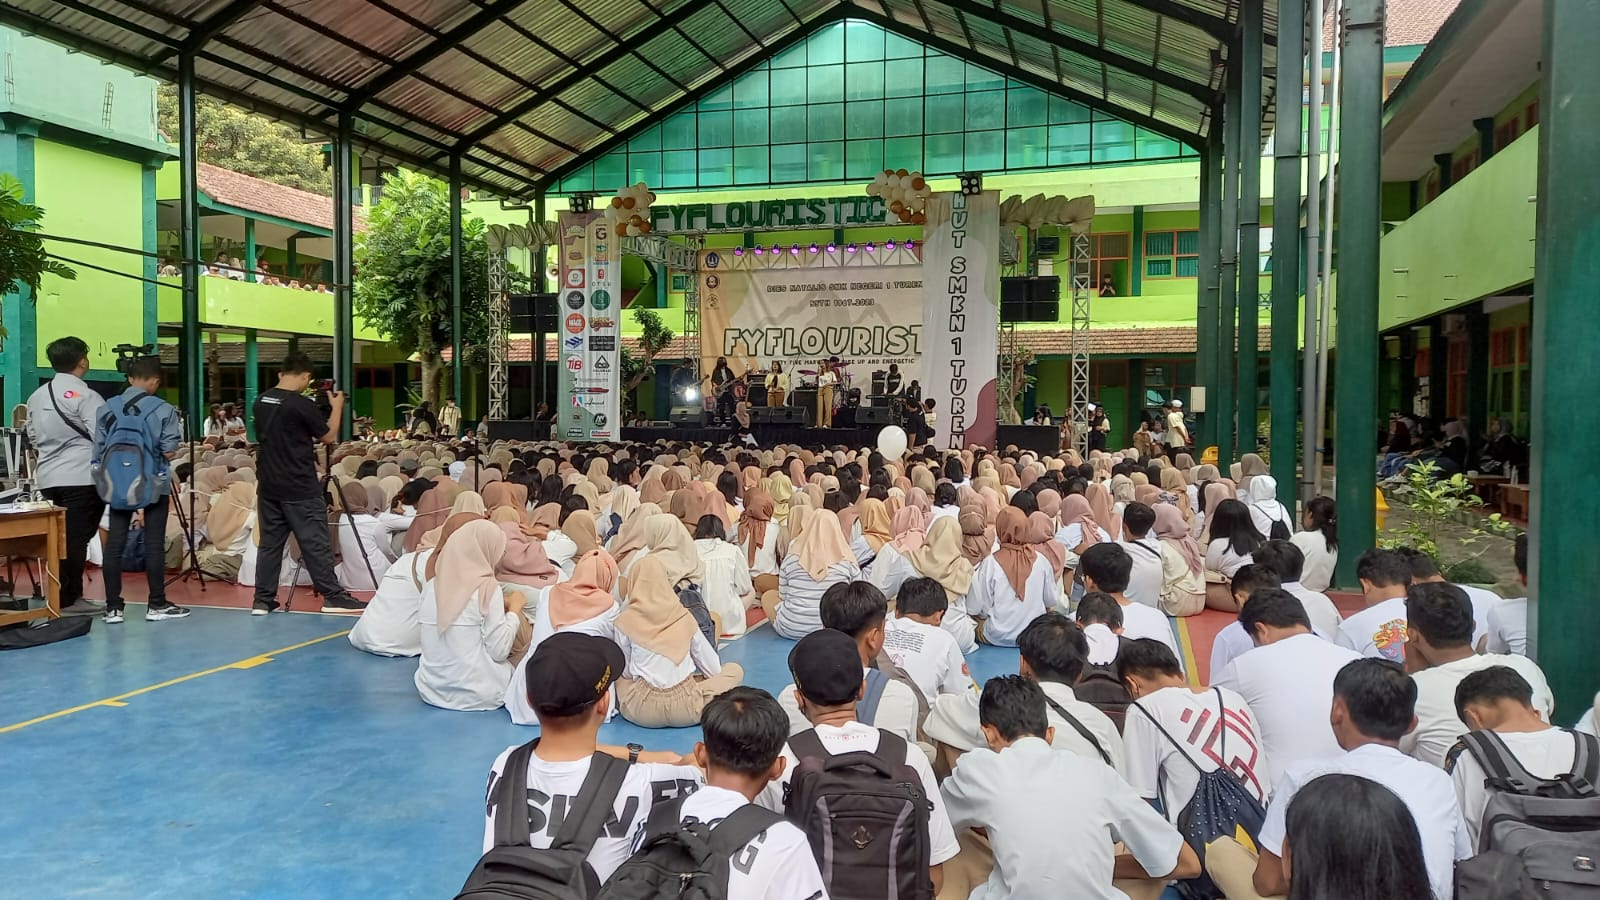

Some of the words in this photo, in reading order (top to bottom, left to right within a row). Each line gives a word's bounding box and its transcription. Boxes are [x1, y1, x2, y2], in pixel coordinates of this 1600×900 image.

[651, 195, 887, 231] FYFLOURISTIC
[951, 191, 968, 249] HUT
[789, 283, 827, 292] NATALIS
[828, 282, 848, 290] SMK
[850, 281, 883, 290] NEGERI
[948, 256, 967, 332] SMKN
[951, 337, 961, 356] 1
[949, 360, 967, 450] TUREN
